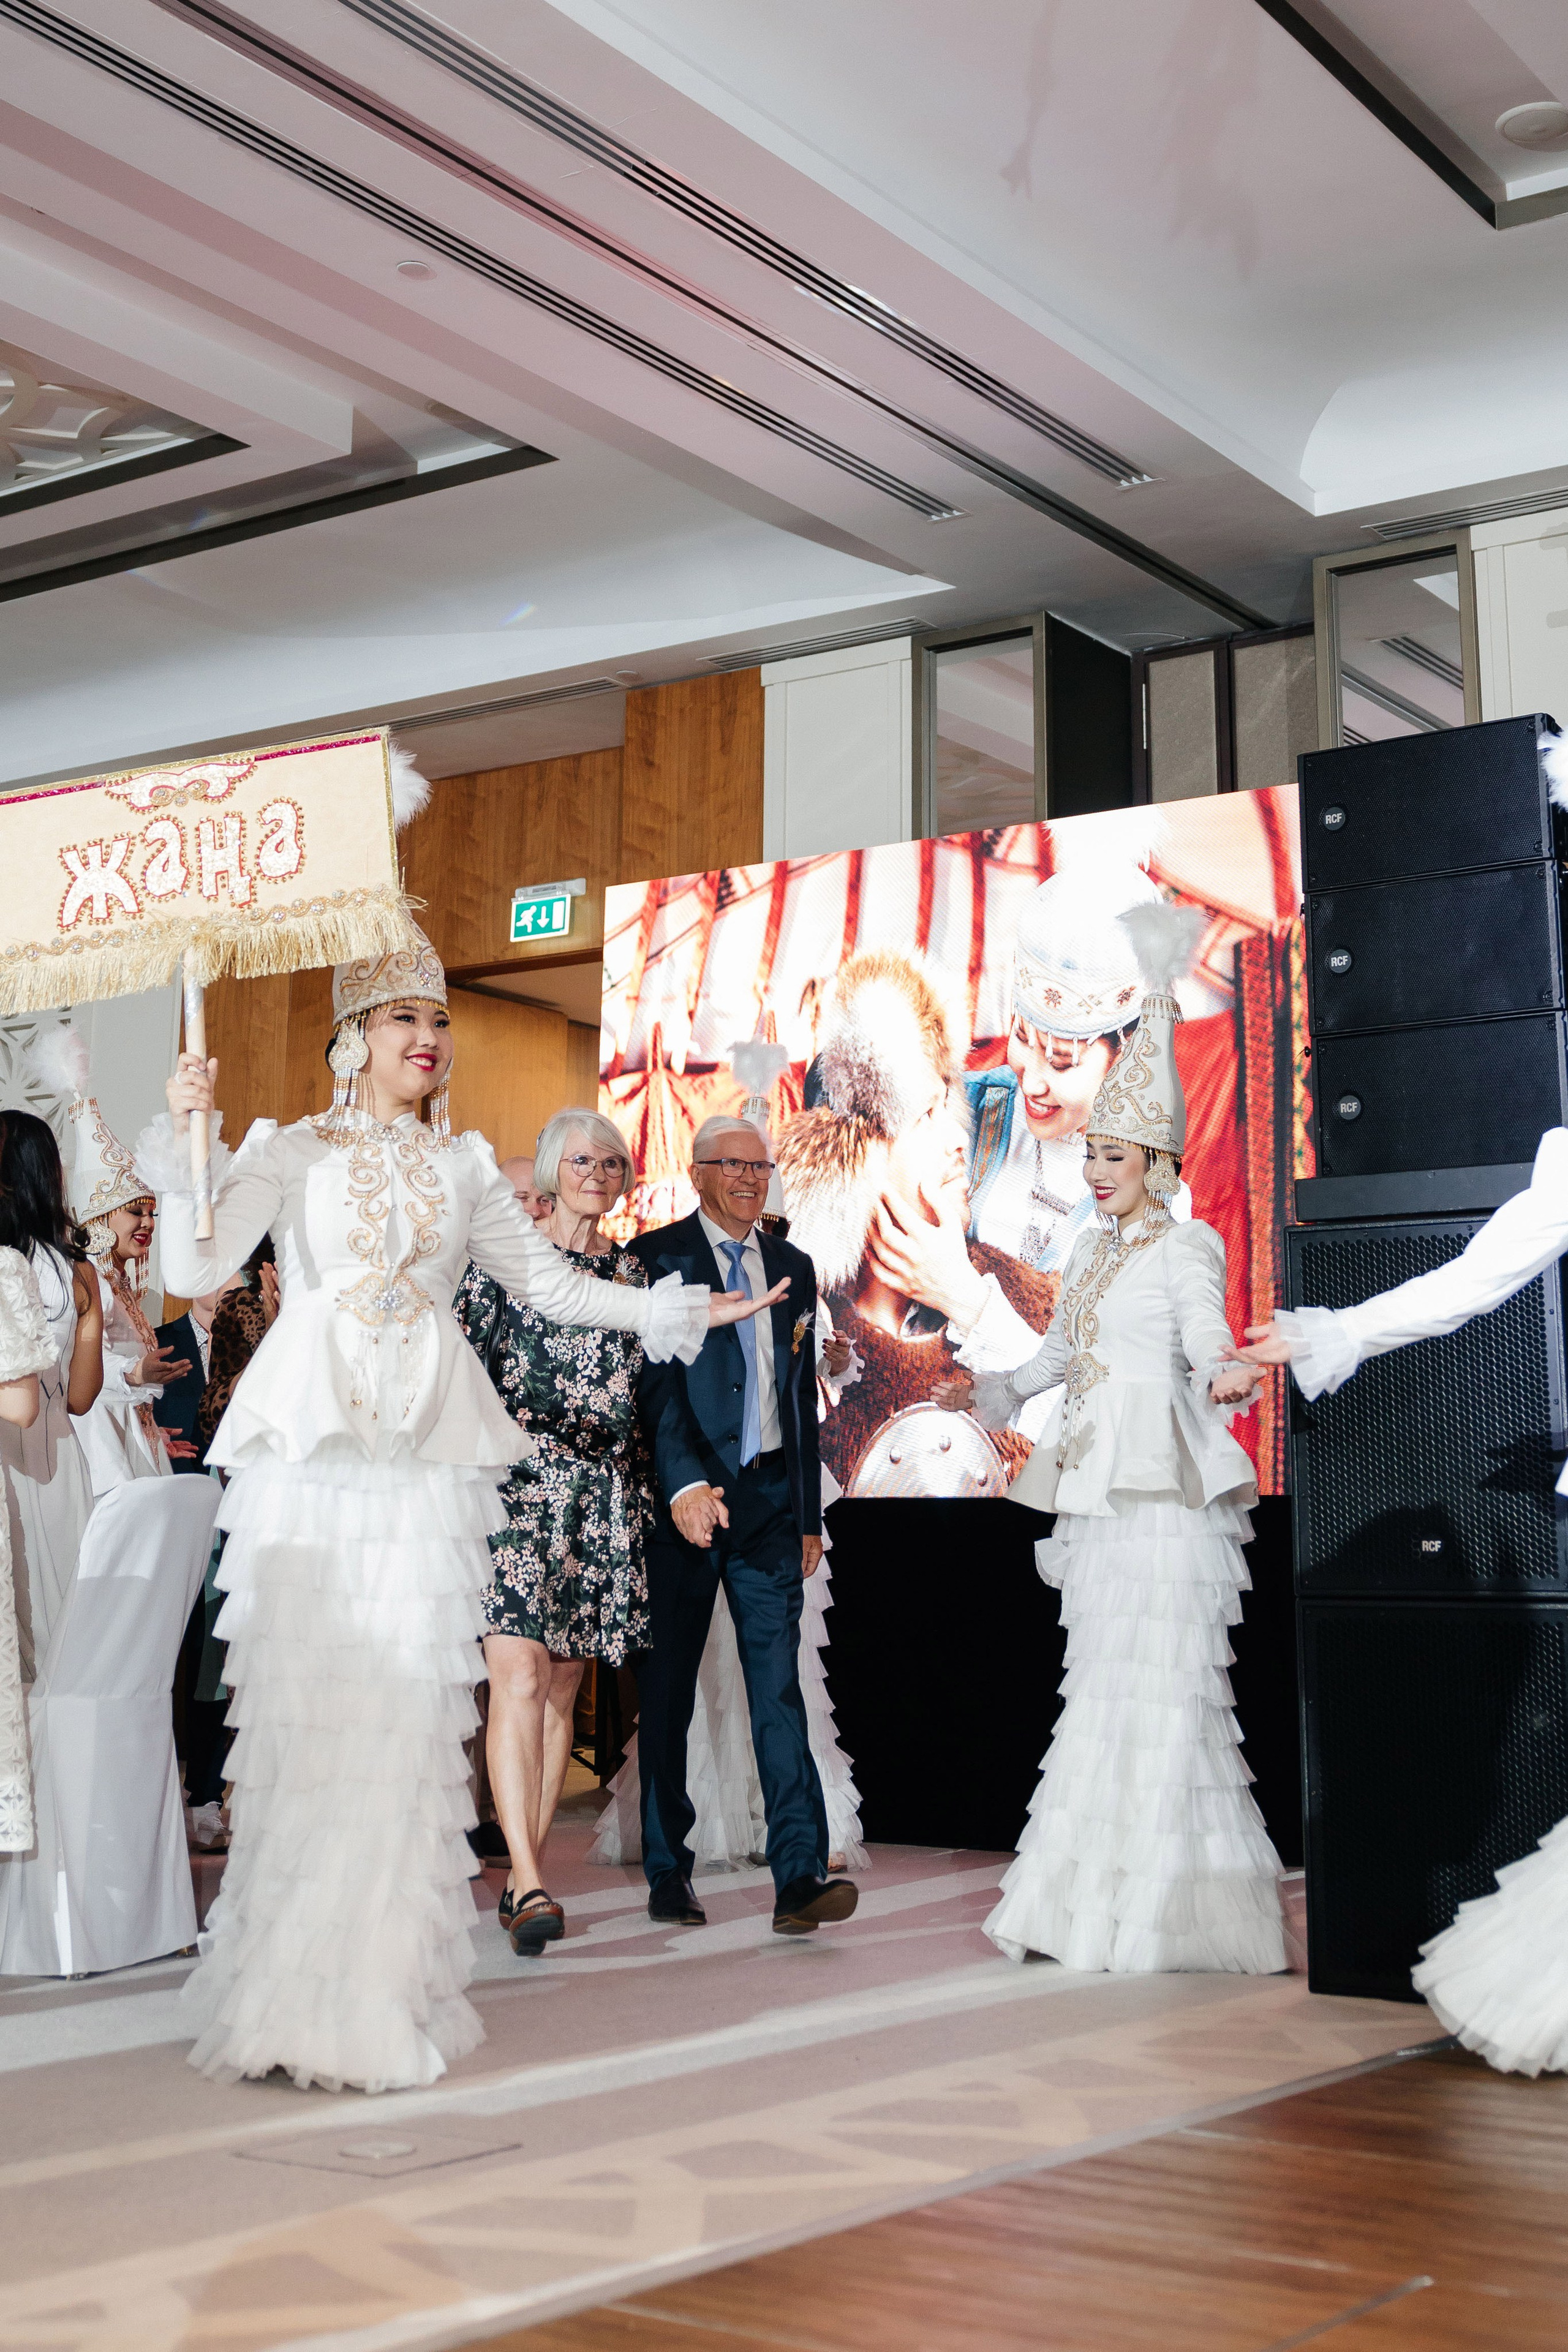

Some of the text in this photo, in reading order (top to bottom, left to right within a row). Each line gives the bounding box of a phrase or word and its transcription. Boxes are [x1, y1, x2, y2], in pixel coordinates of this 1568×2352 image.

[1325, 812, 1343, 824] RCF
[1330, 955, 1348, 967] RCF
[1340, 1102, 1358, 1114] RCF
[1422, 1540, 1442, 1552] RCF
